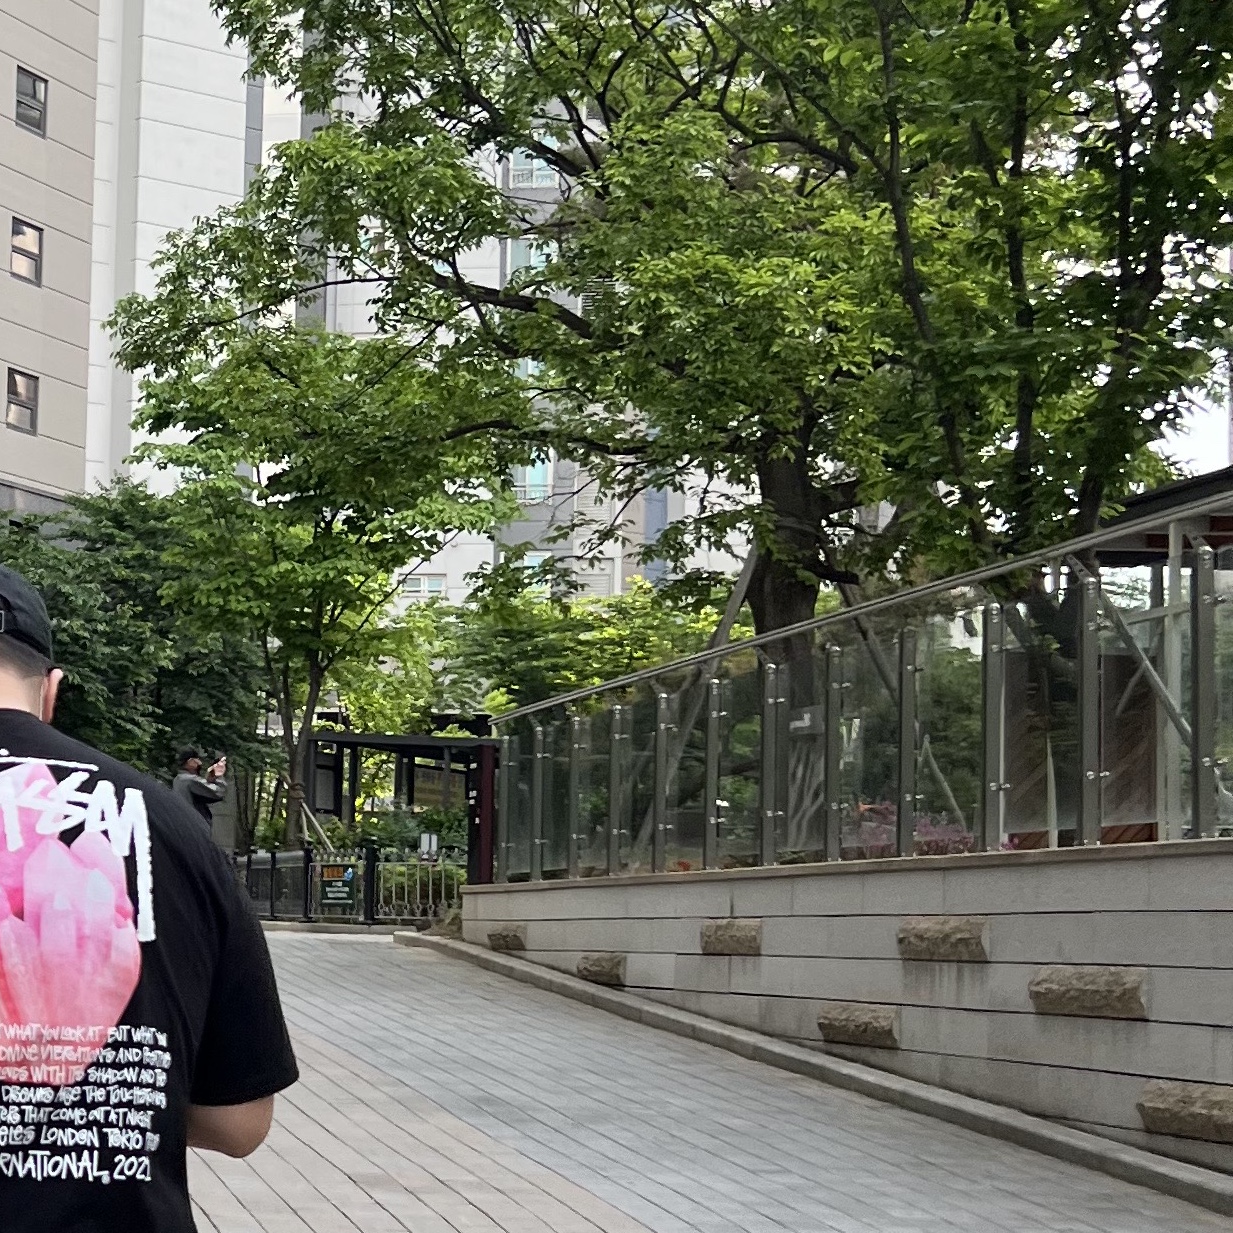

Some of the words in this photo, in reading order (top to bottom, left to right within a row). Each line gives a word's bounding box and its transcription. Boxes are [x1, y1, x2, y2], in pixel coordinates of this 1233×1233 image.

[4, 1023, 41, 1041] WHAT
[107, 1025, 131, 1043] BUT
[115, 1047, 143, 1064] AND
[30, 1063, 67, 1085] WITH
[86, 1065, 139, 1085] SHADOW
[82, 1085, 106, 1104] THE
[20, 1105, 54, 1124] THAT
[51, 1107, 88, 1126] COME
[39, 1124, 100, 1148] LONDON
[101, 1127, 144, 1151] TOKYO
[113, 1153, 152, 1182] 2021
